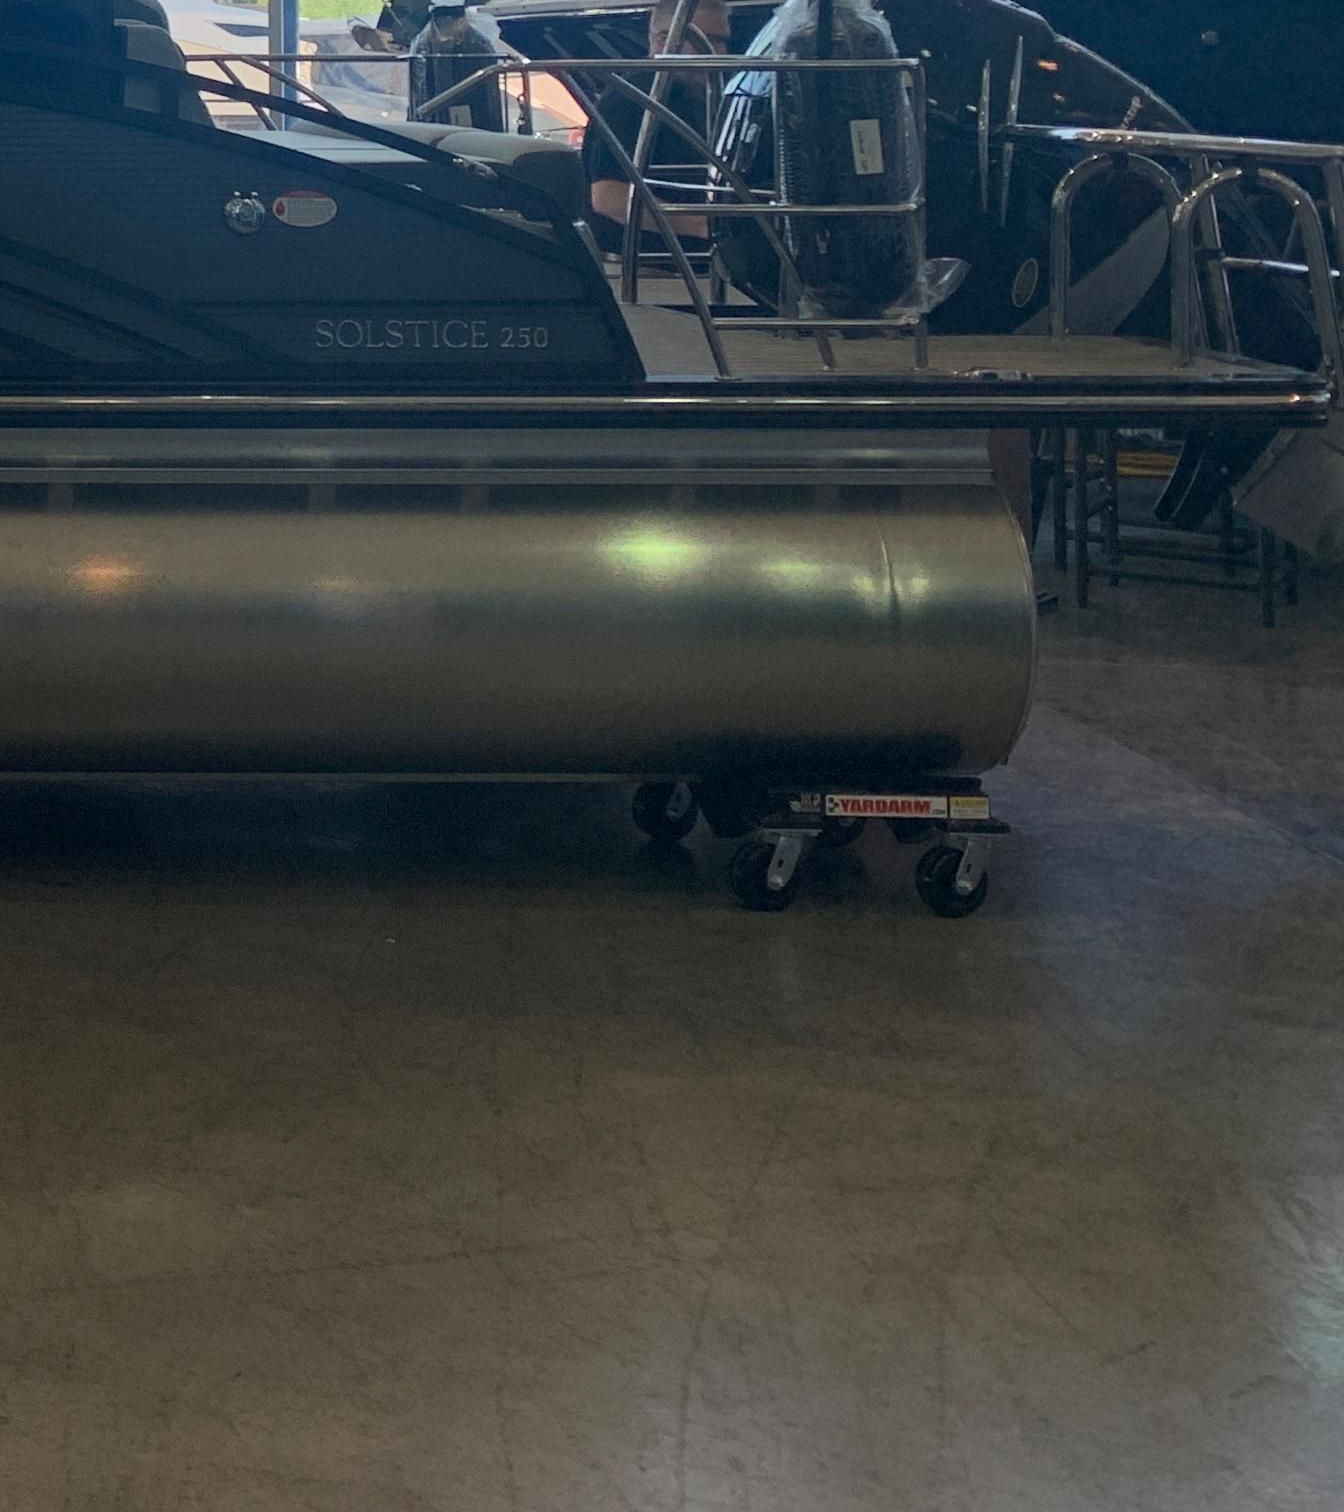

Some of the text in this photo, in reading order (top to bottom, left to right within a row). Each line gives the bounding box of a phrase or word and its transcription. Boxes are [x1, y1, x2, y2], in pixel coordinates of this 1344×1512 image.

[315, 319, 549, 349] SOLSTICE 250
[839, 797, 931, 814] YARDARM
